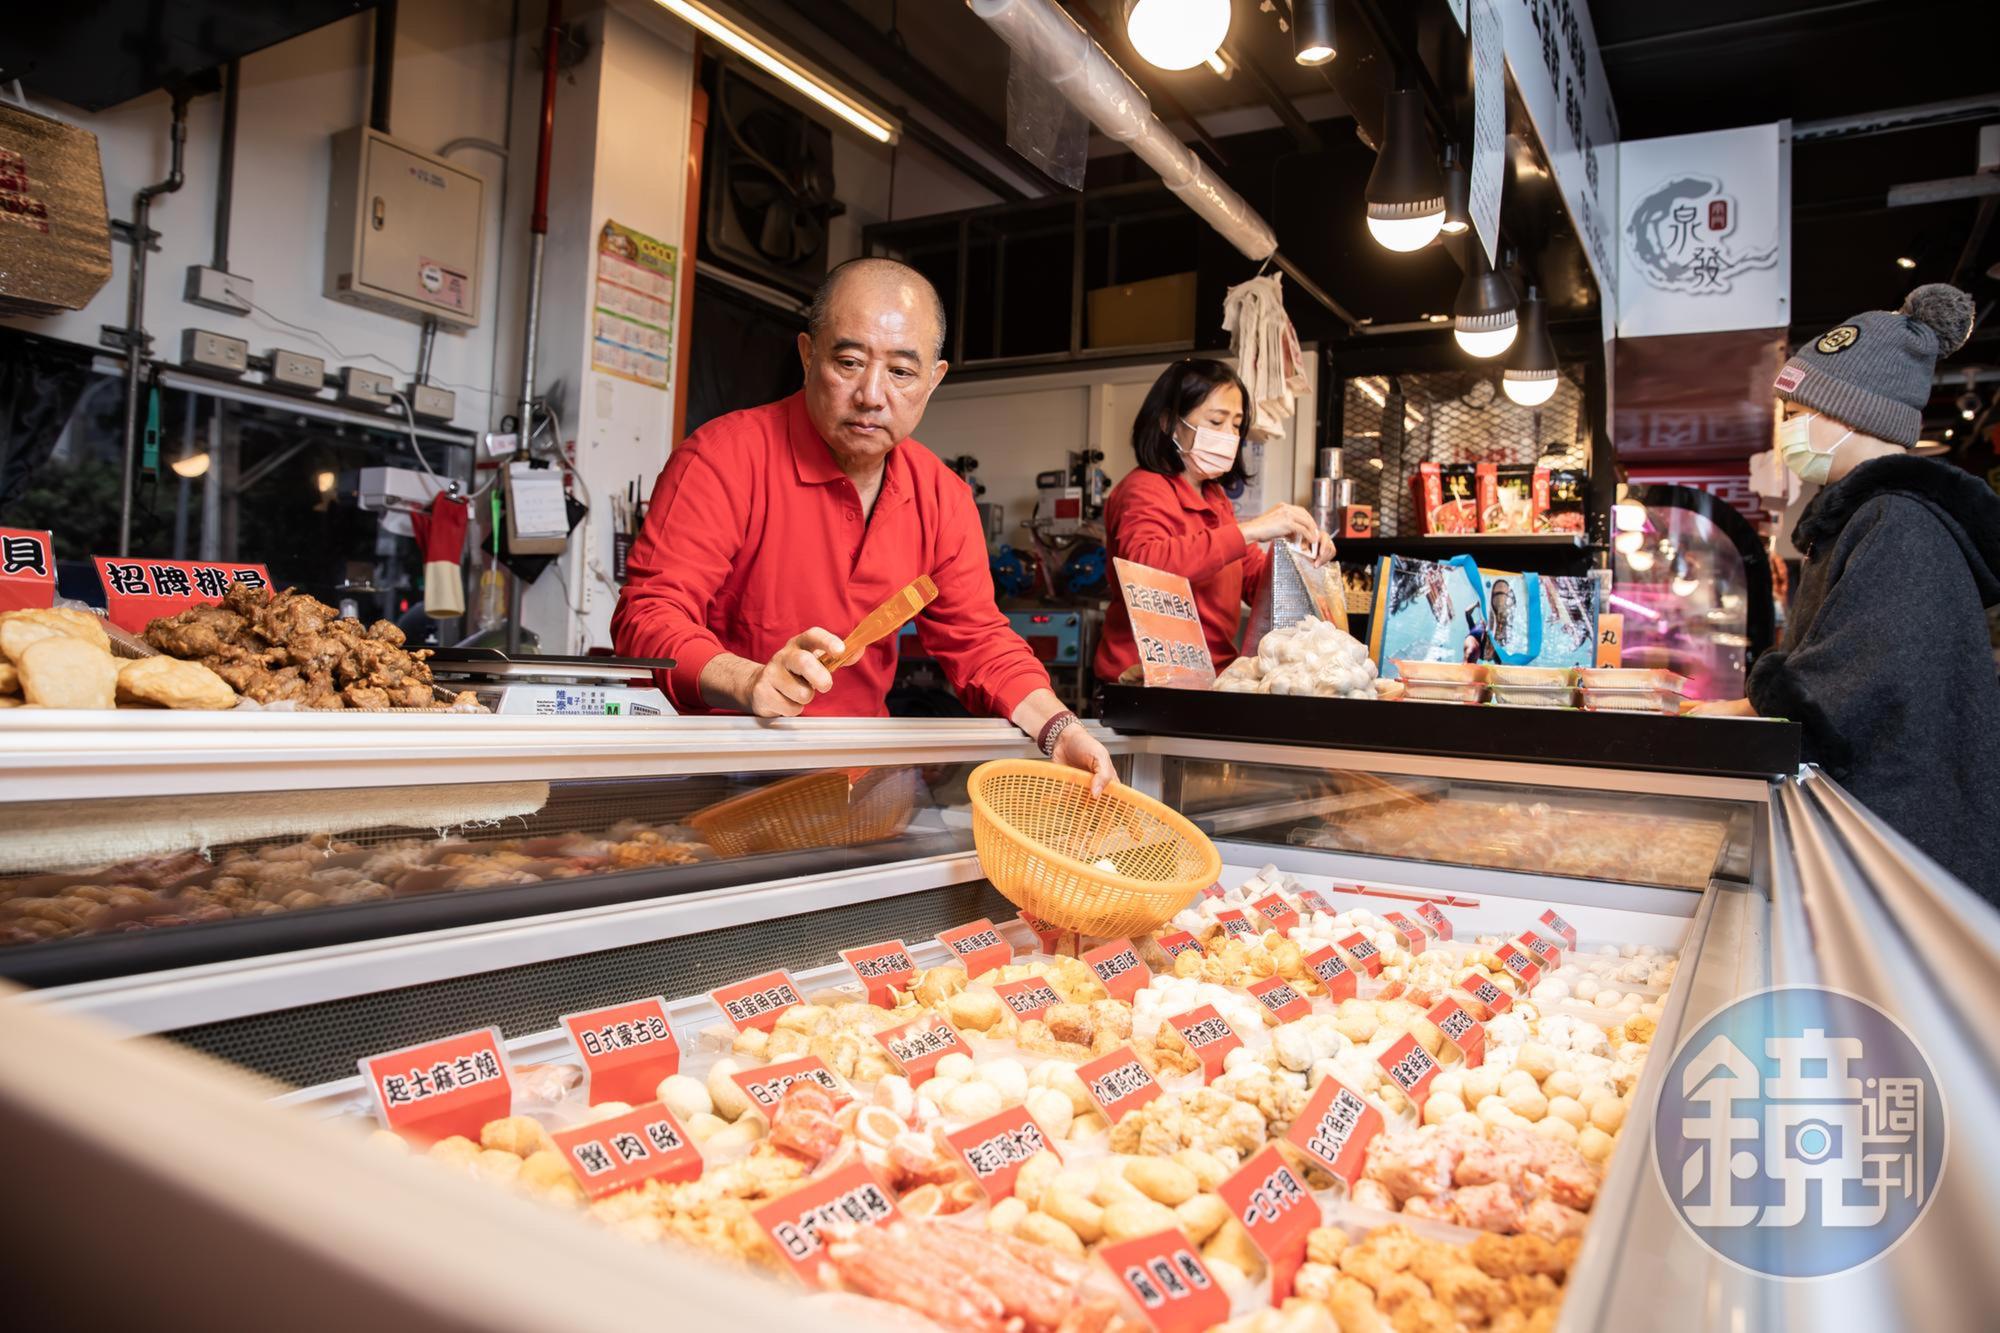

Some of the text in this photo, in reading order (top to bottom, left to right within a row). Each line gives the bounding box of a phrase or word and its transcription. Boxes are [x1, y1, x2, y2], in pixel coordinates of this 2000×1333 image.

[106, 563, 266, 598] 招牌排骨
[583, 1016, 667, 1056] 日式蒙古包
[385, 1051, 500, 1104] 起士麻吉燒
